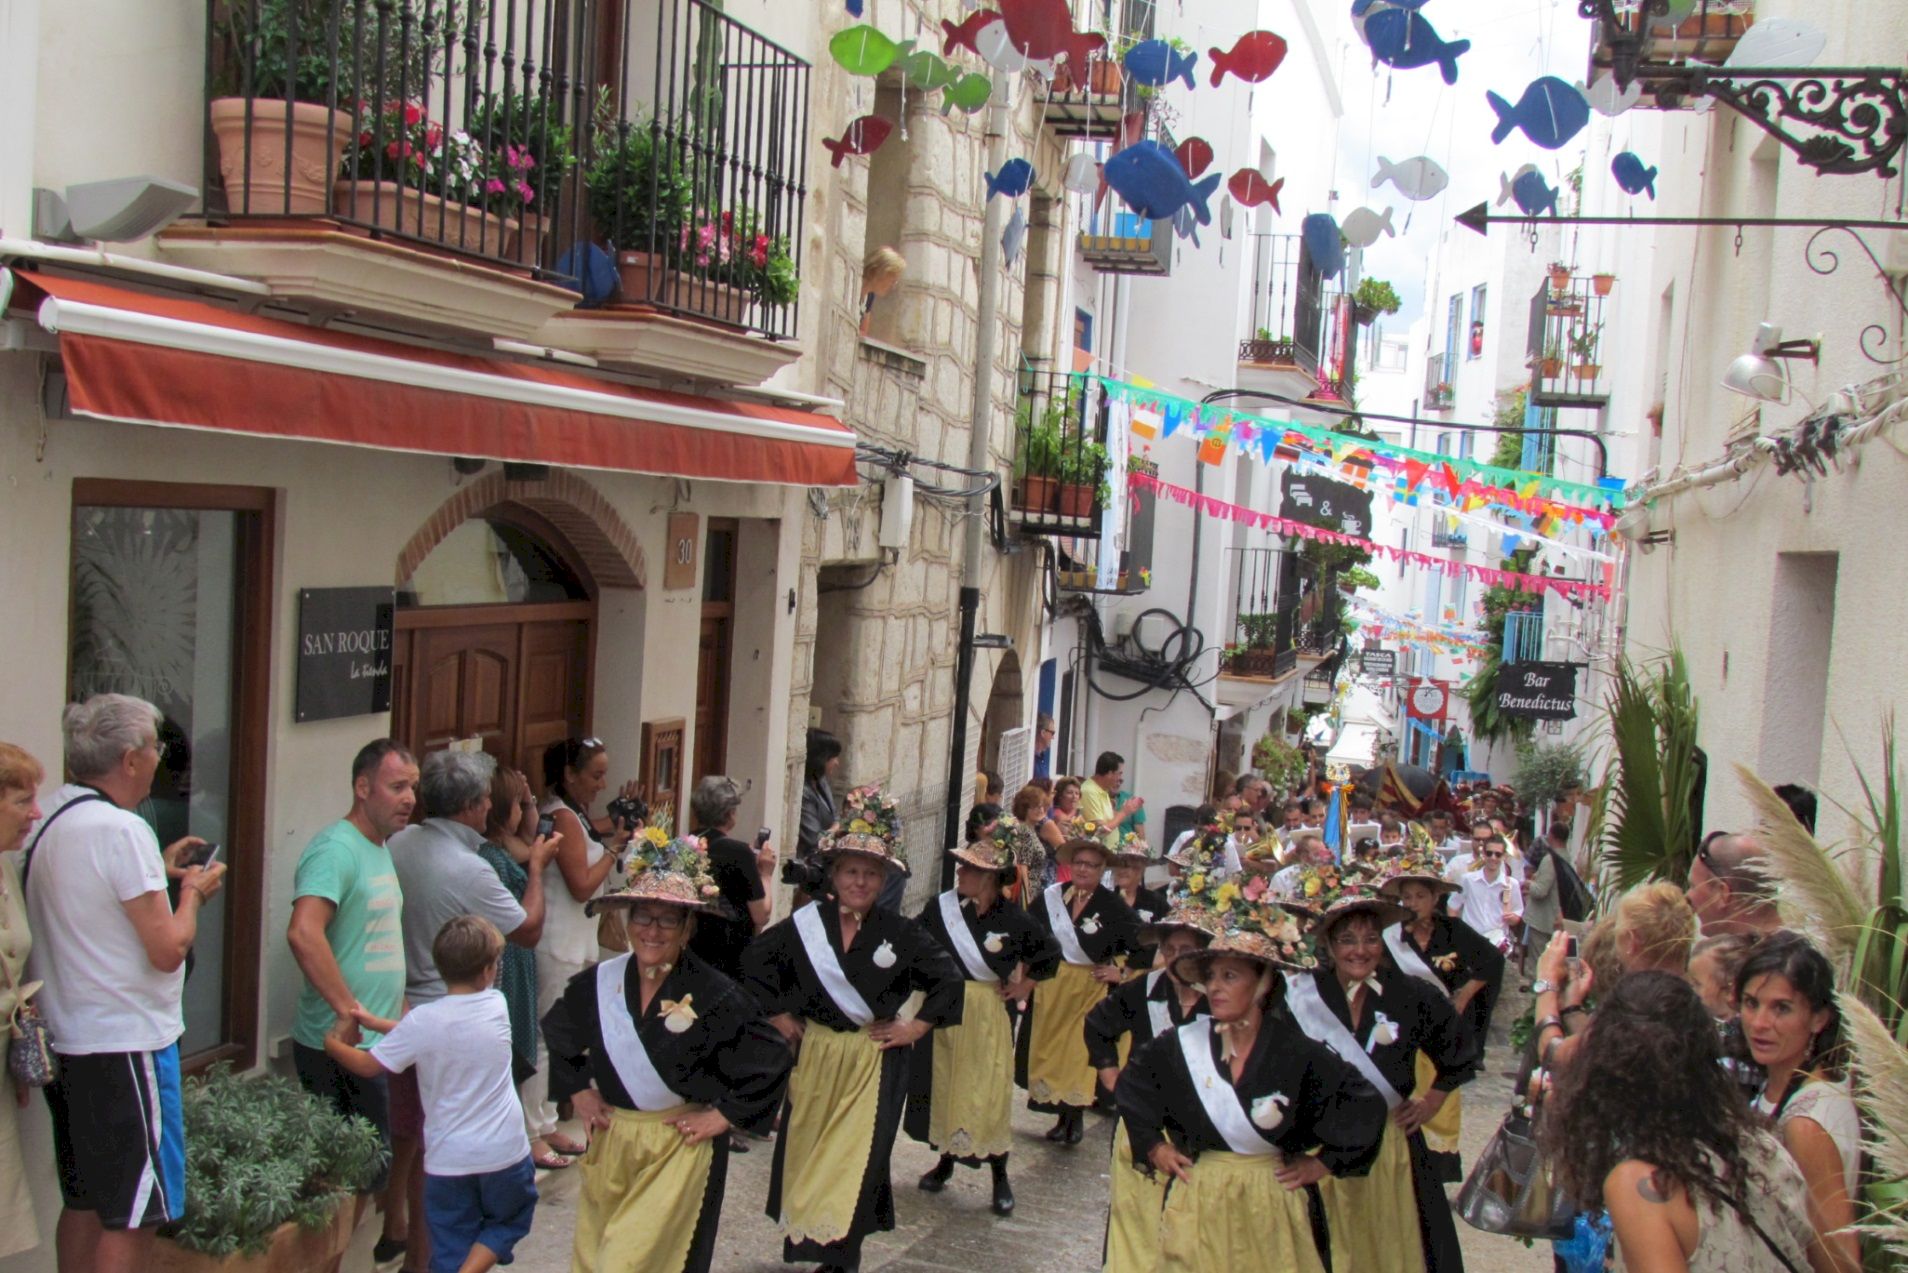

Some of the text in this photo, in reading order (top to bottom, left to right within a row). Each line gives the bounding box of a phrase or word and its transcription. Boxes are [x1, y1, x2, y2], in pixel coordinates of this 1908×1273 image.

[1320, 500, 1332, 516] &
[678, 539, 692, 564] 30
[304, 629, 390, 655] SAN ROQUE
[362, 660, 388, 678] tienda
[1523, 671, 1551, 687] Bar
[1498, 692, 1573, 711] Benedictus
